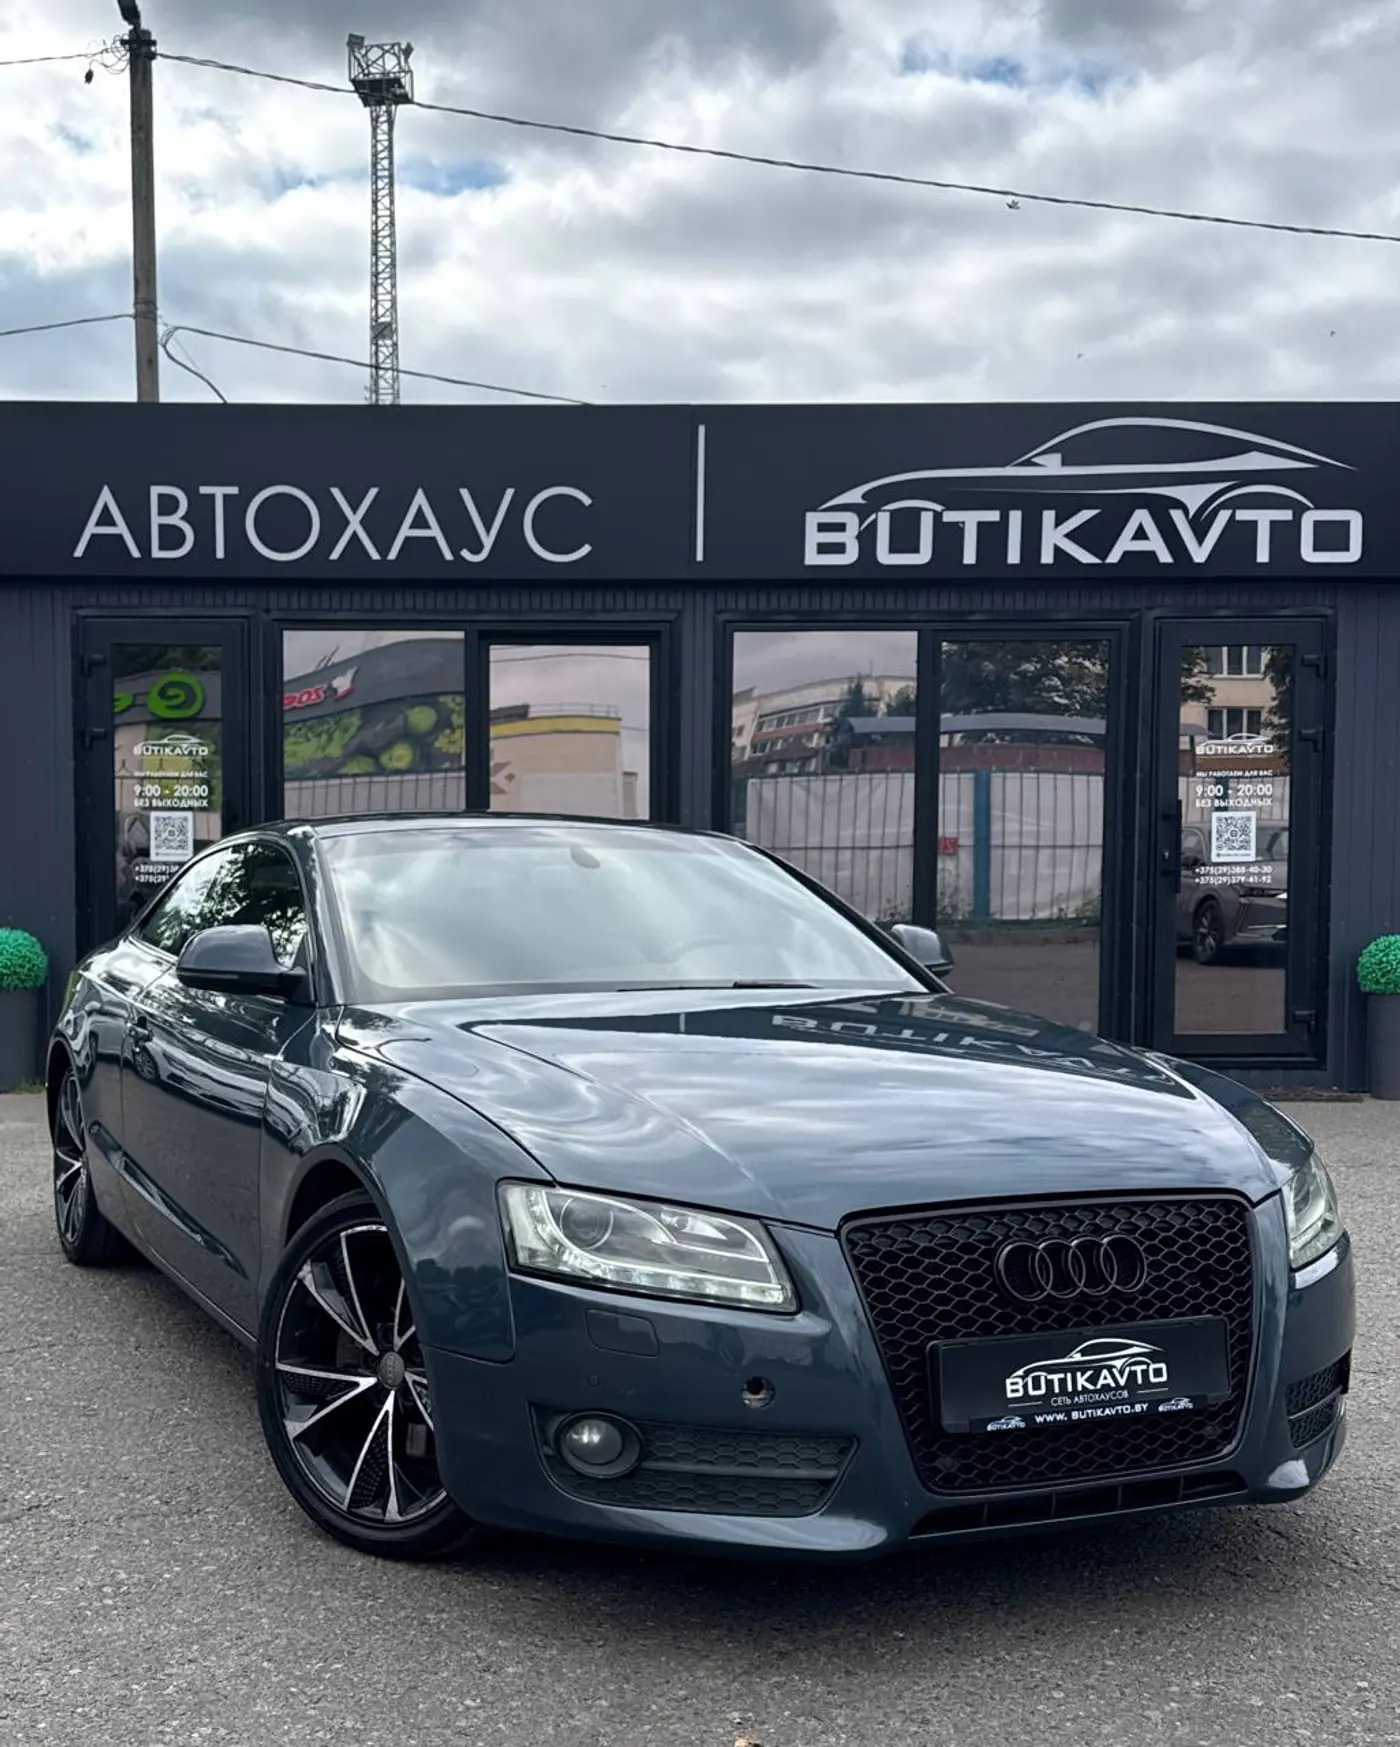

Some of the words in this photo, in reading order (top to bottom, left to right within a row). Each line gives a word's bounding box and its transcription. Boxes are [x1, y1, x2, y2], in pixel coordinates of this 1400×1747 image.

[73, 484, 593, 563] АВТОХАУС
[803, 509, 1363, 566] BUTIKAVTO
[1195, 745, 1274, 755] BUTIKAVTO
[133, 784, 161, 797] 9:00
[173, 784, 209, 797] 20:00
[1195, 784, 1224, 797] 9:00
[1237, 784, 1273, 796] 20:00
[1006, 1362, 1168, 1399] BUTIKAVTO
[1050, 1396, 1072, 1406] СЕТЬ
[1073, 1390, 1129, 1405] АВТОХАУСОВ
[1034, 1412, 1067, 1424] WWW.
[1071, 1402, 1149, 1420] BUTIKAVTO.BY
